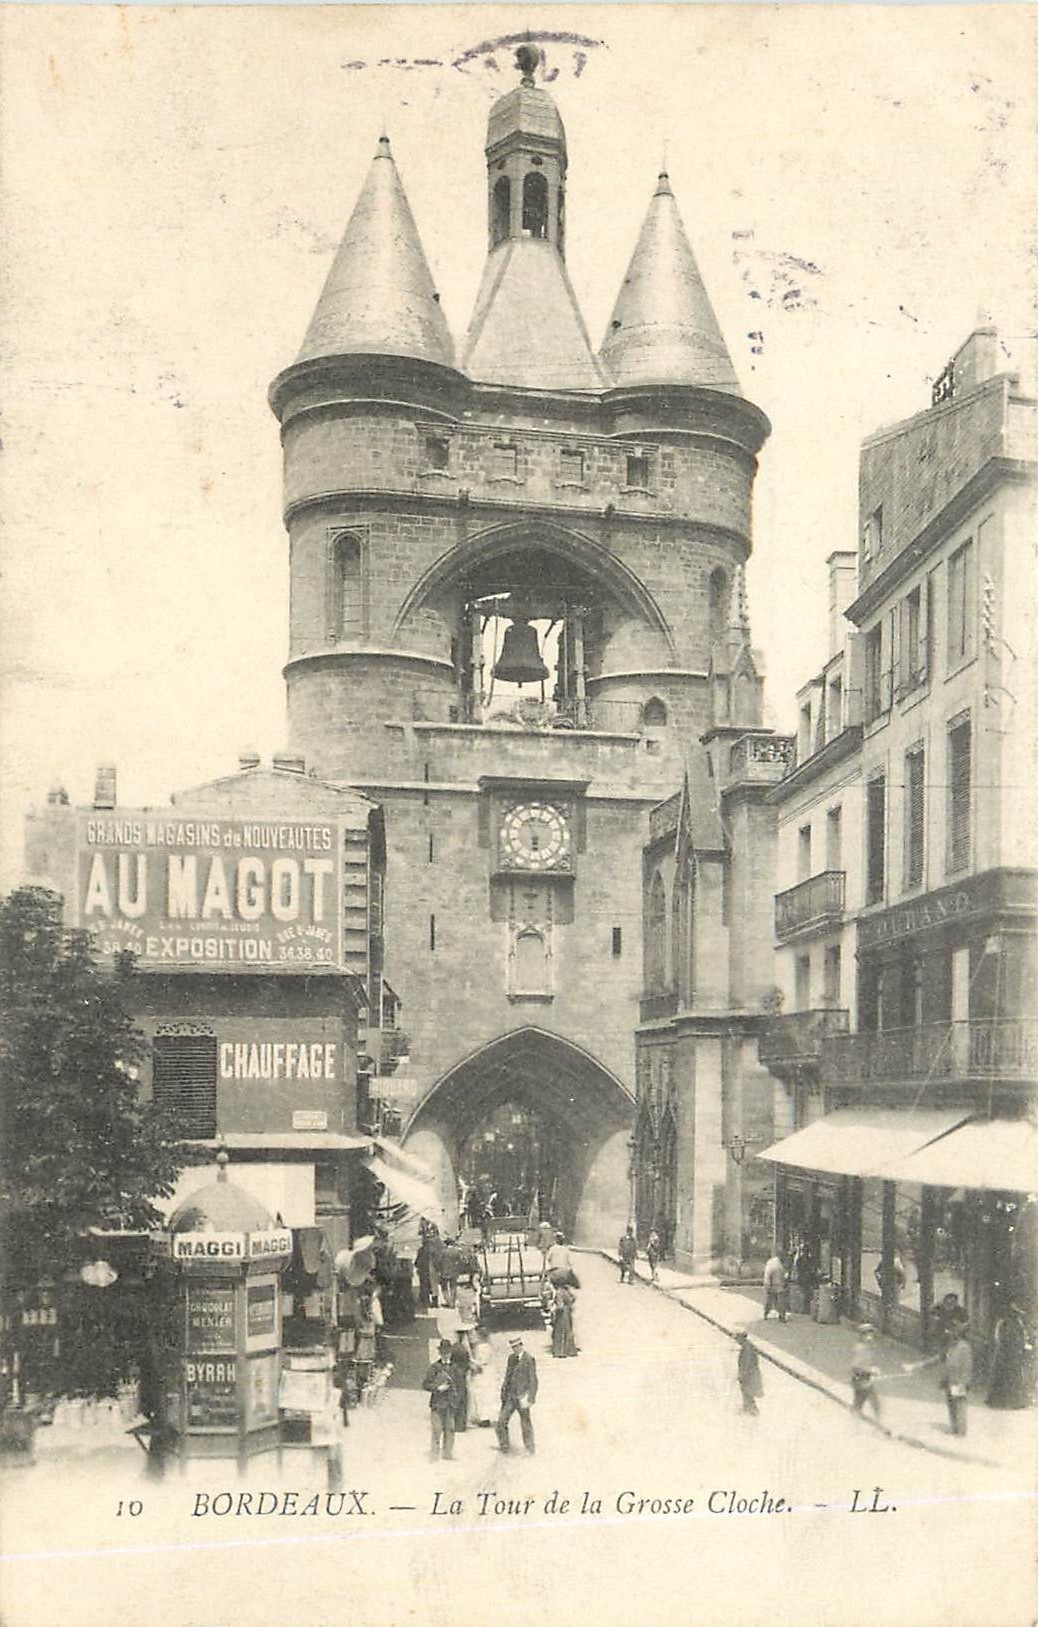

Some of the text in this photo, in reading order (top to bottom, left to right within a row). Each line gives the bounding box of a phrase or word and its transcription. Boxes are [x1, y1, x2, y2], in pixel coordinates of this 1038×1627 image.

[87, 820, 142, 845] GRANDS
[146, 822, 221, 847] MAGASINS
[223, 829, 241, 848] de
[84, 852, 335, 922] AU MAGOT
[146, 936, 272, 960] EXPOSITION
[220, 1043, 336, 1079] CHAUFFAGE
[177, 1241, 241, 1256] MAGGI
[252, 1237, 291, 1253] MAGGI
[187, 1363, 236, 1382] BYRRH
